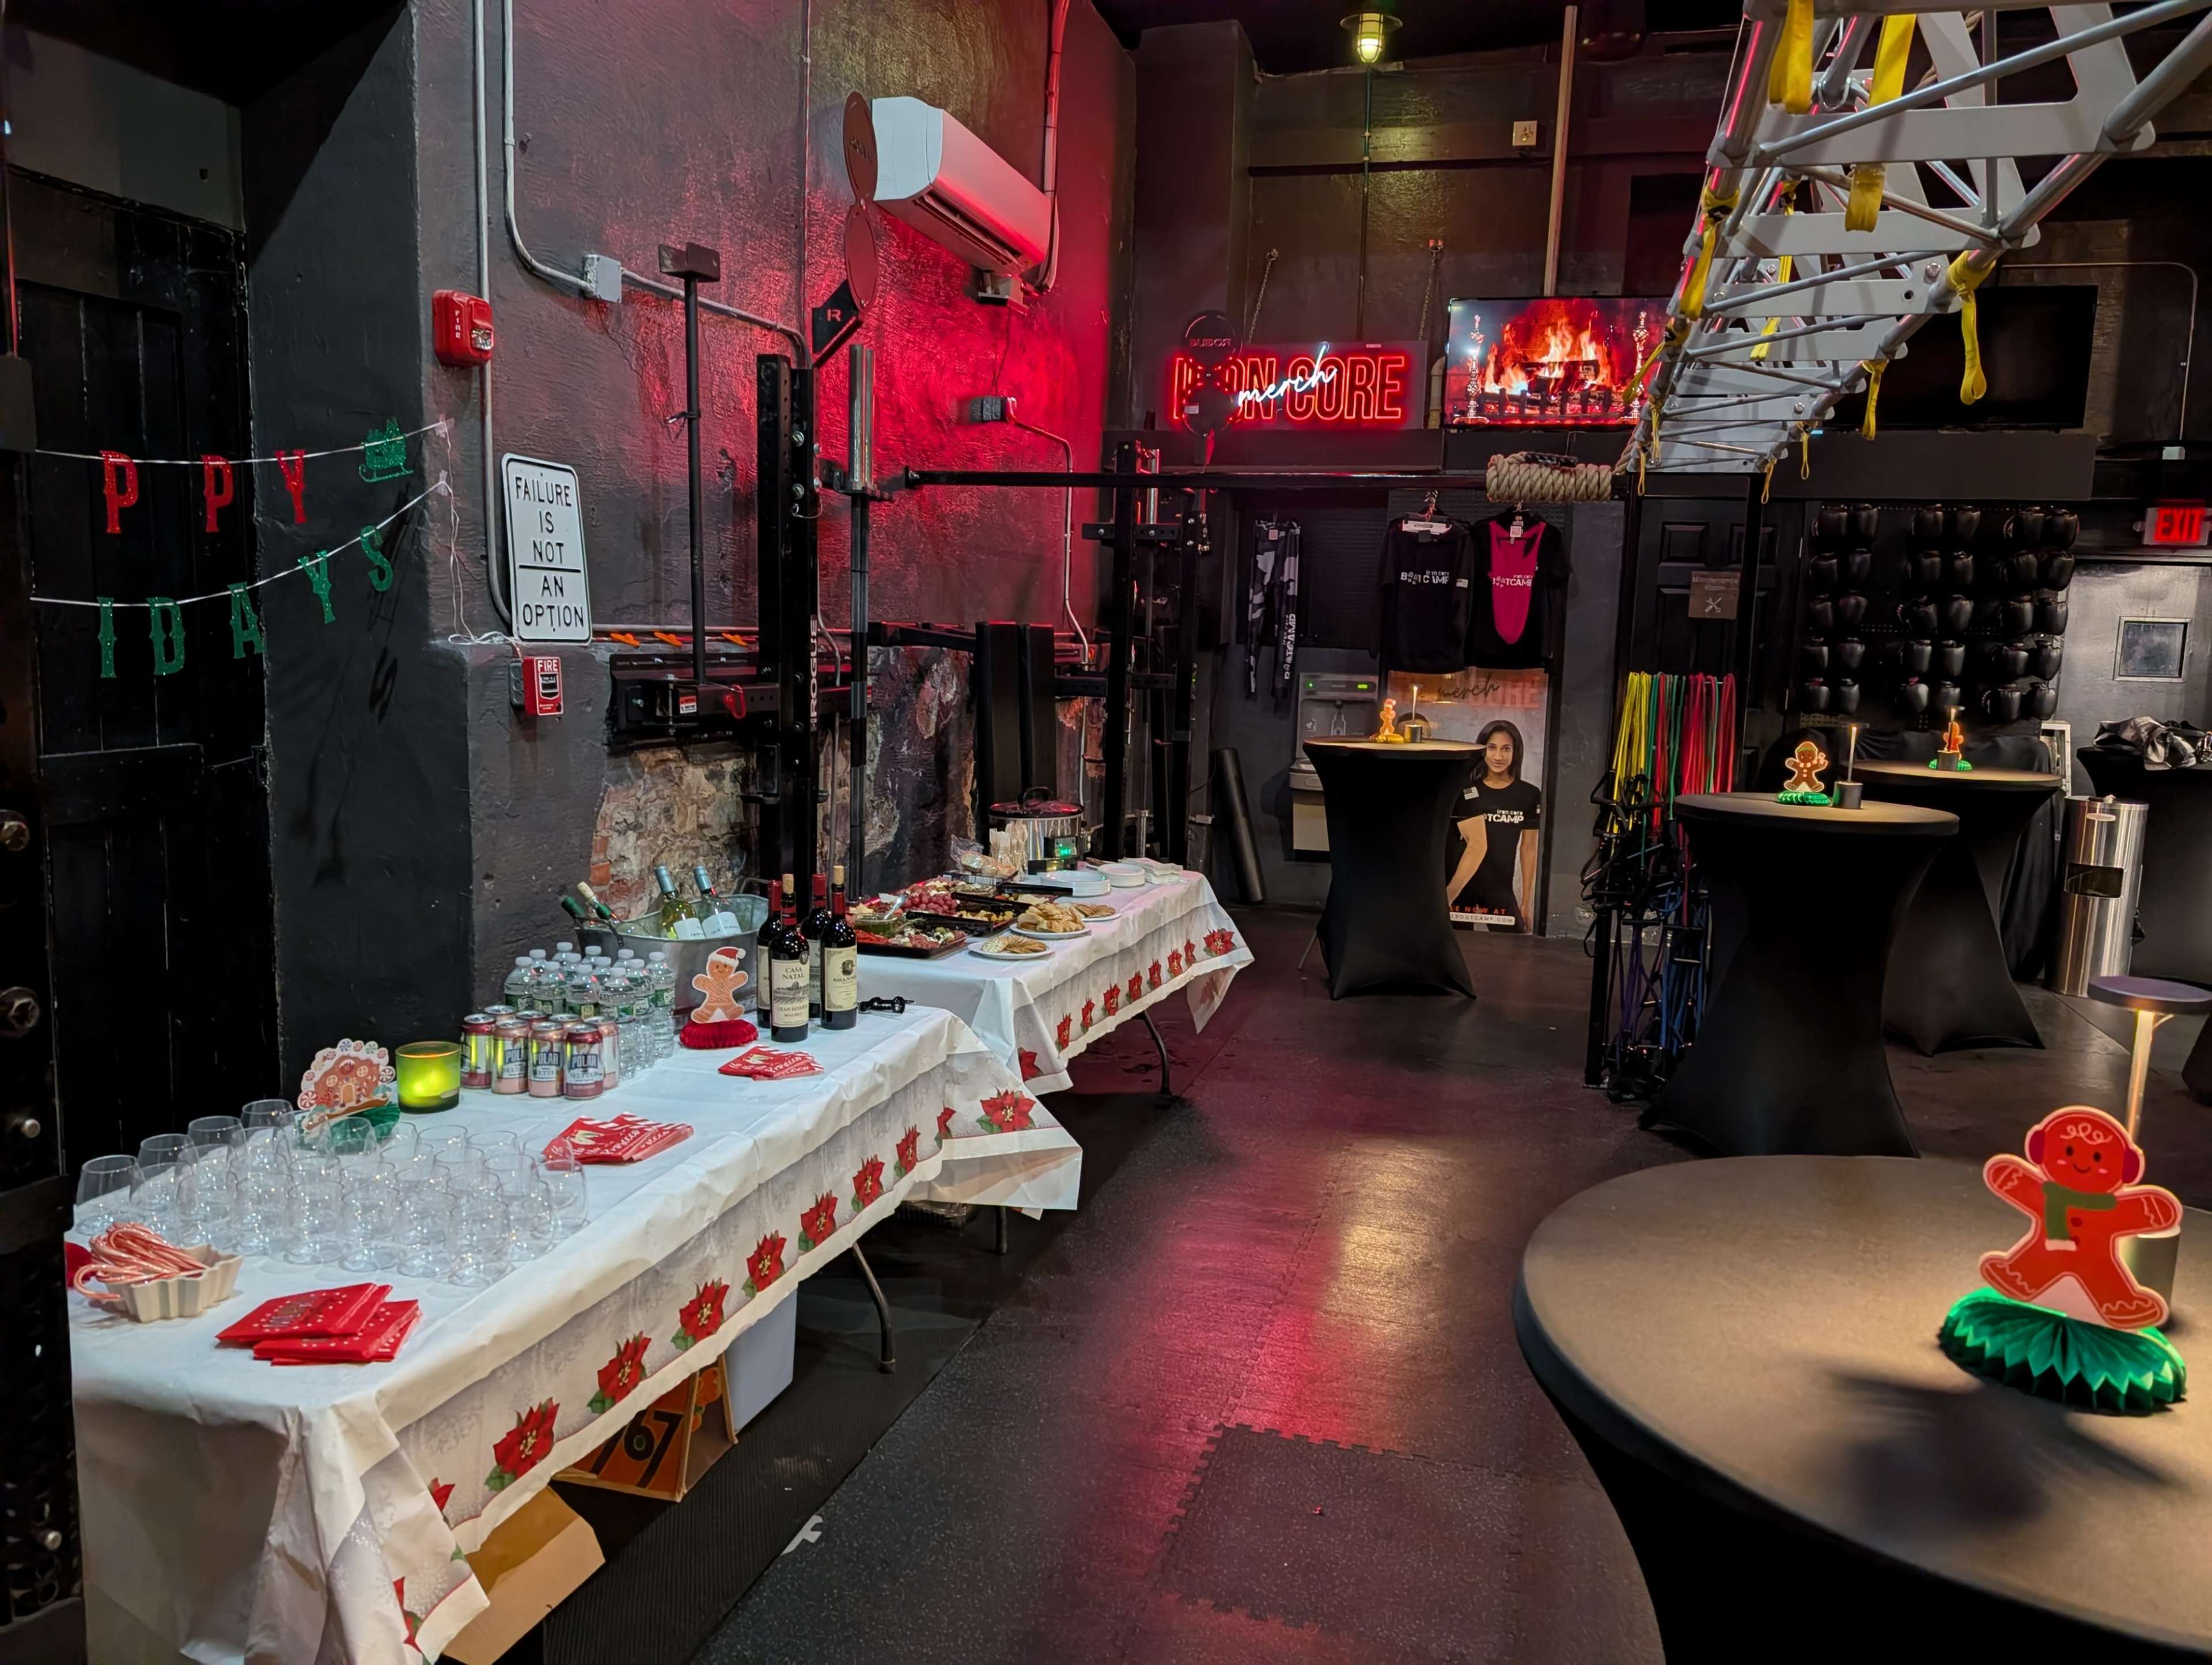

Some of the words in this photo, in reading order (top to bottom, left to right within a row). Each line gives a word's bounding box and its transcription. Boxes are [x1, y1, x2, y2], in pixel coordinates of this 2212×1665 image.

[1238, 342, 1338, 406] merch
[1285, 355, 1405, 421] CORE
[515, 476, 572, 507] FAILURE
[539, 511, 554, 533] IS
[2154, 507, 2206, 542] EXIT
[533, 540, 564, 564] NOT
[541, 575, 563, 597] AN
[522, 604, 584, 627] OPTION
[537, 659, 558, 672] FIRE
[571, 1055, 597, 1068] POLAR
